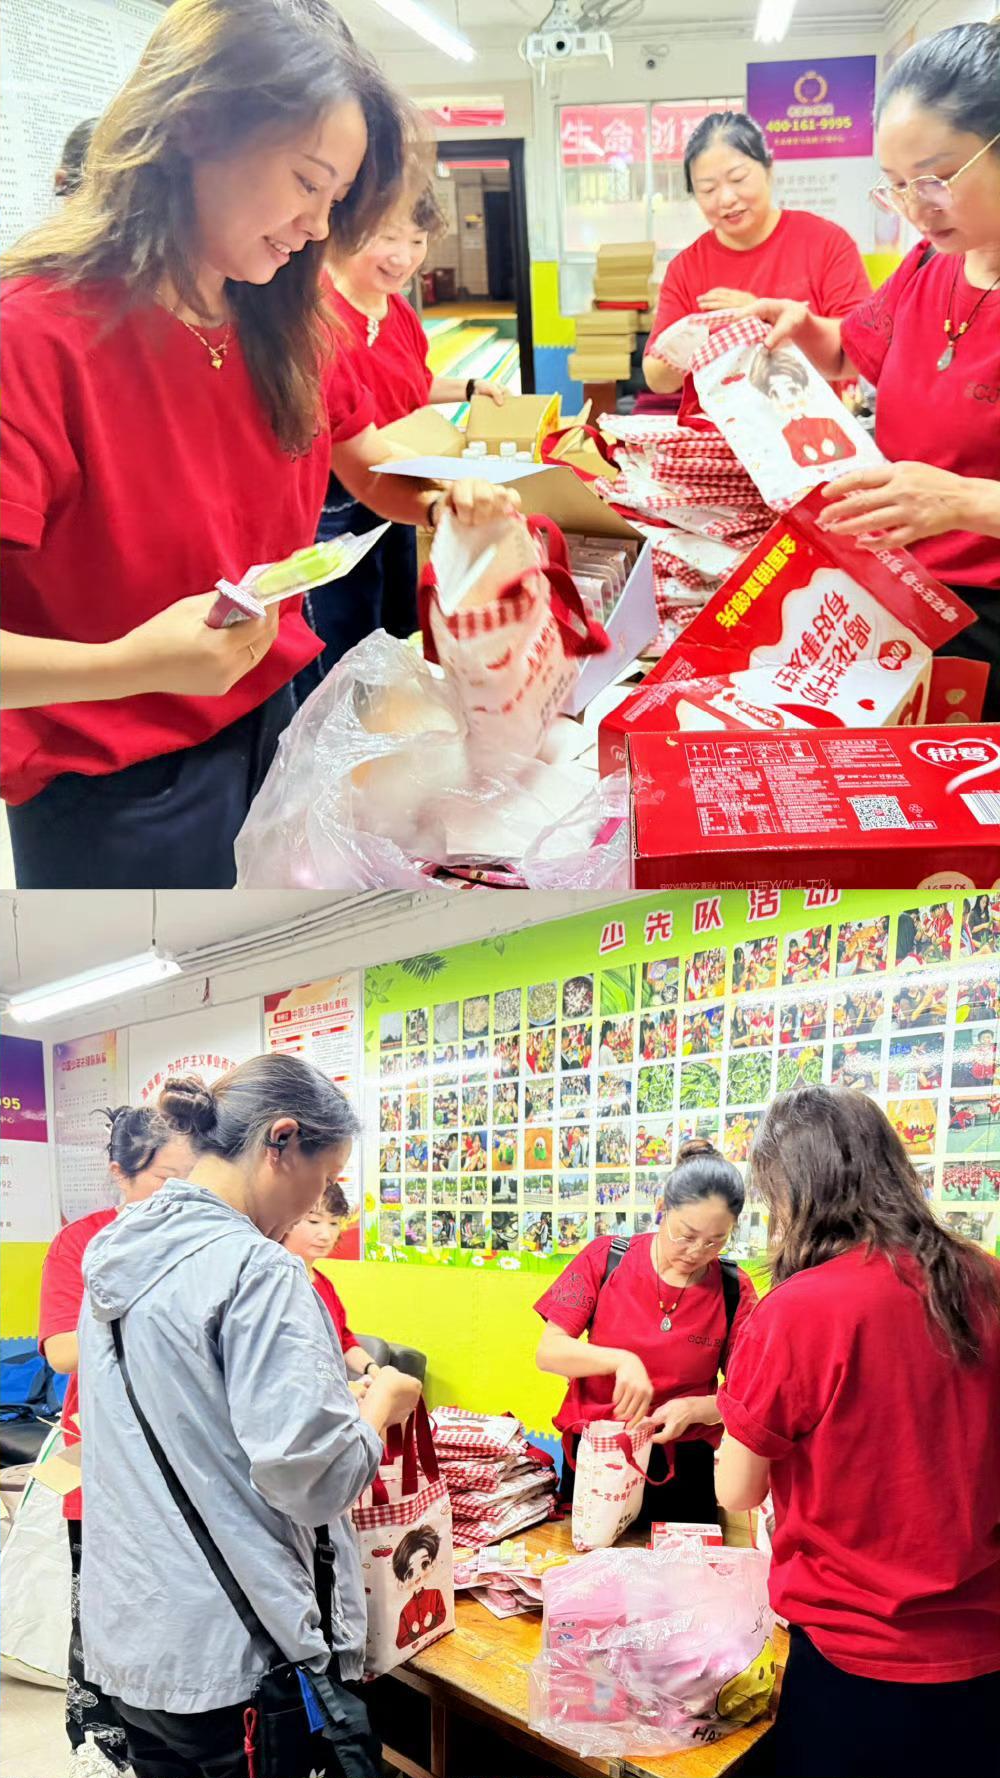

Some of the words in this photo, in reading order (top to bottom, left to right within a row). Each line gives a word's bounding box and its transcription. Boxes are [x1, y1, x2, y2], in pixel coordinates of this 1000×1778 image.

[715, 533, 796, 631] 全国销量领先
[927, 747, 991, 762] 银鹭
[0, 1096, 21, 1111] 95
